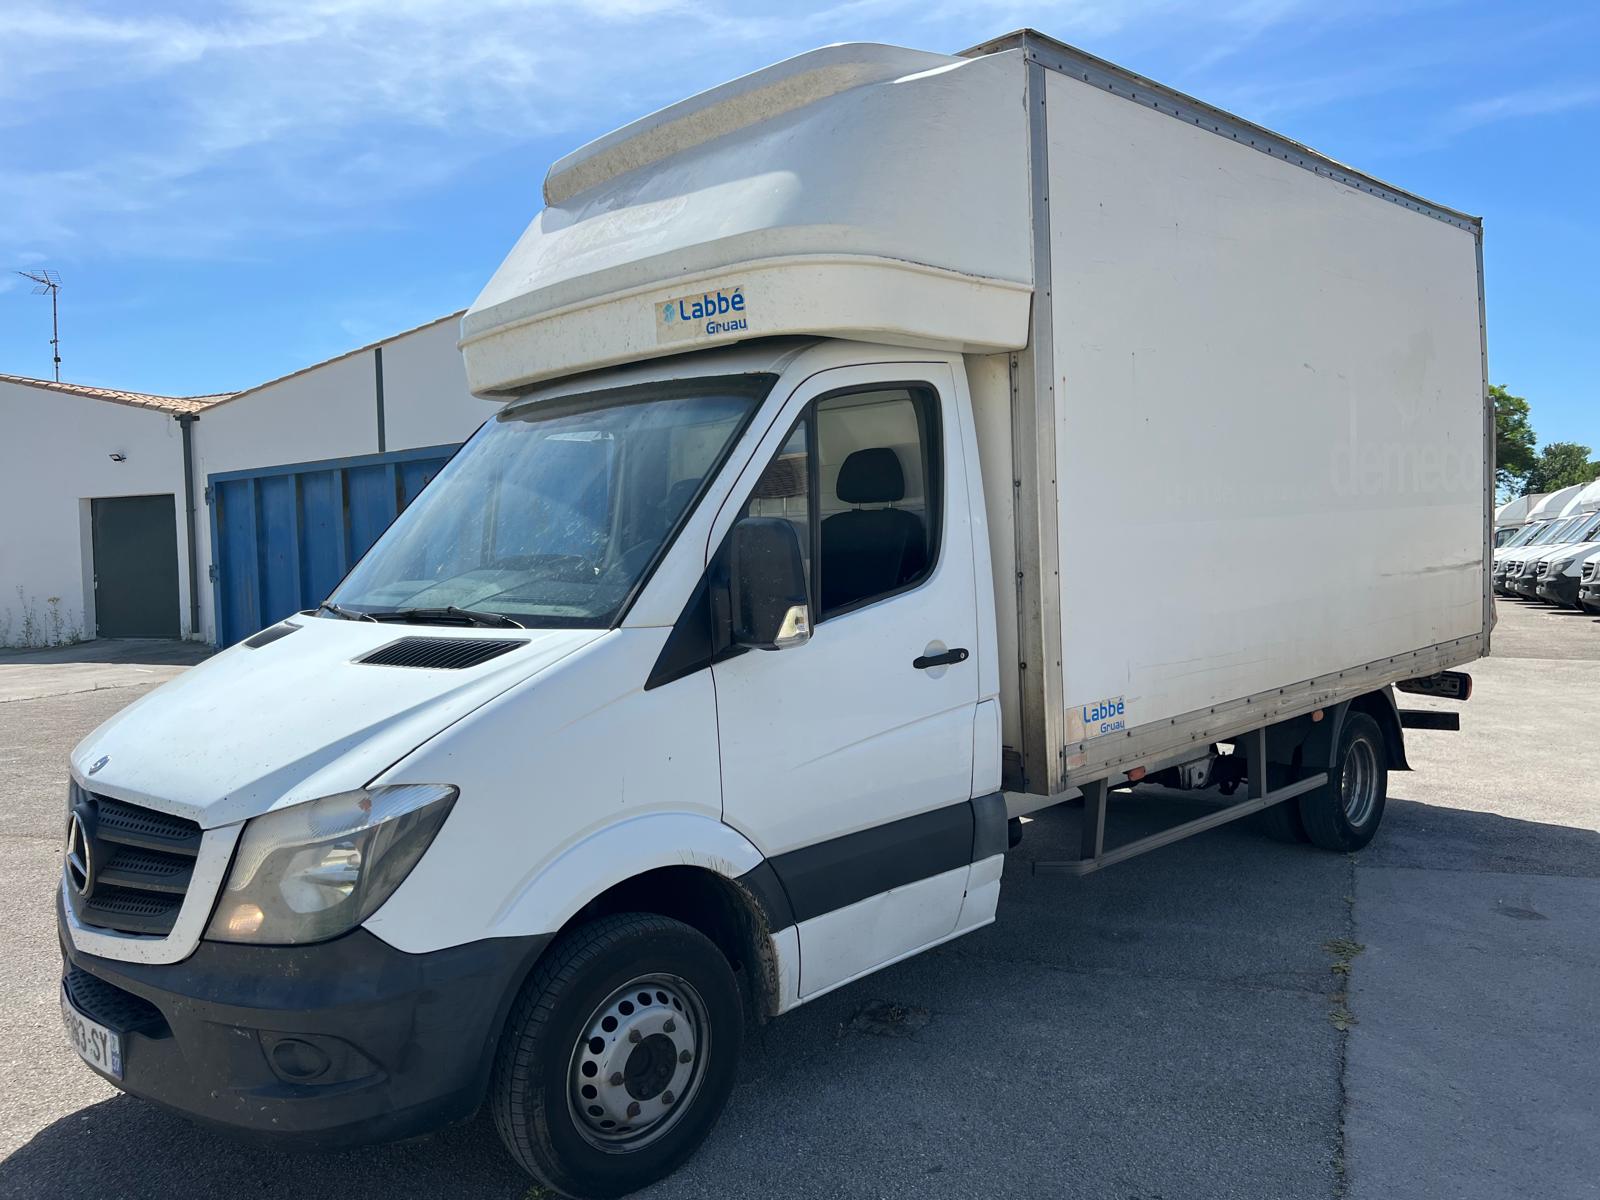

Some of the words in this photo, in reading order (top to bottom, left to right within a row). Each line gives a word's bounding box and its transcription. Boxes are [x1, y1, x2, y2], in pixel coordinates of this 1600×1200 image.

[679, 287, 745, 321] Labbé
[706, 318, 747, 335] Gruau
[1083, 697, 1125, 723] Labbé
[1100, 720, 1125, 733] Gruau
